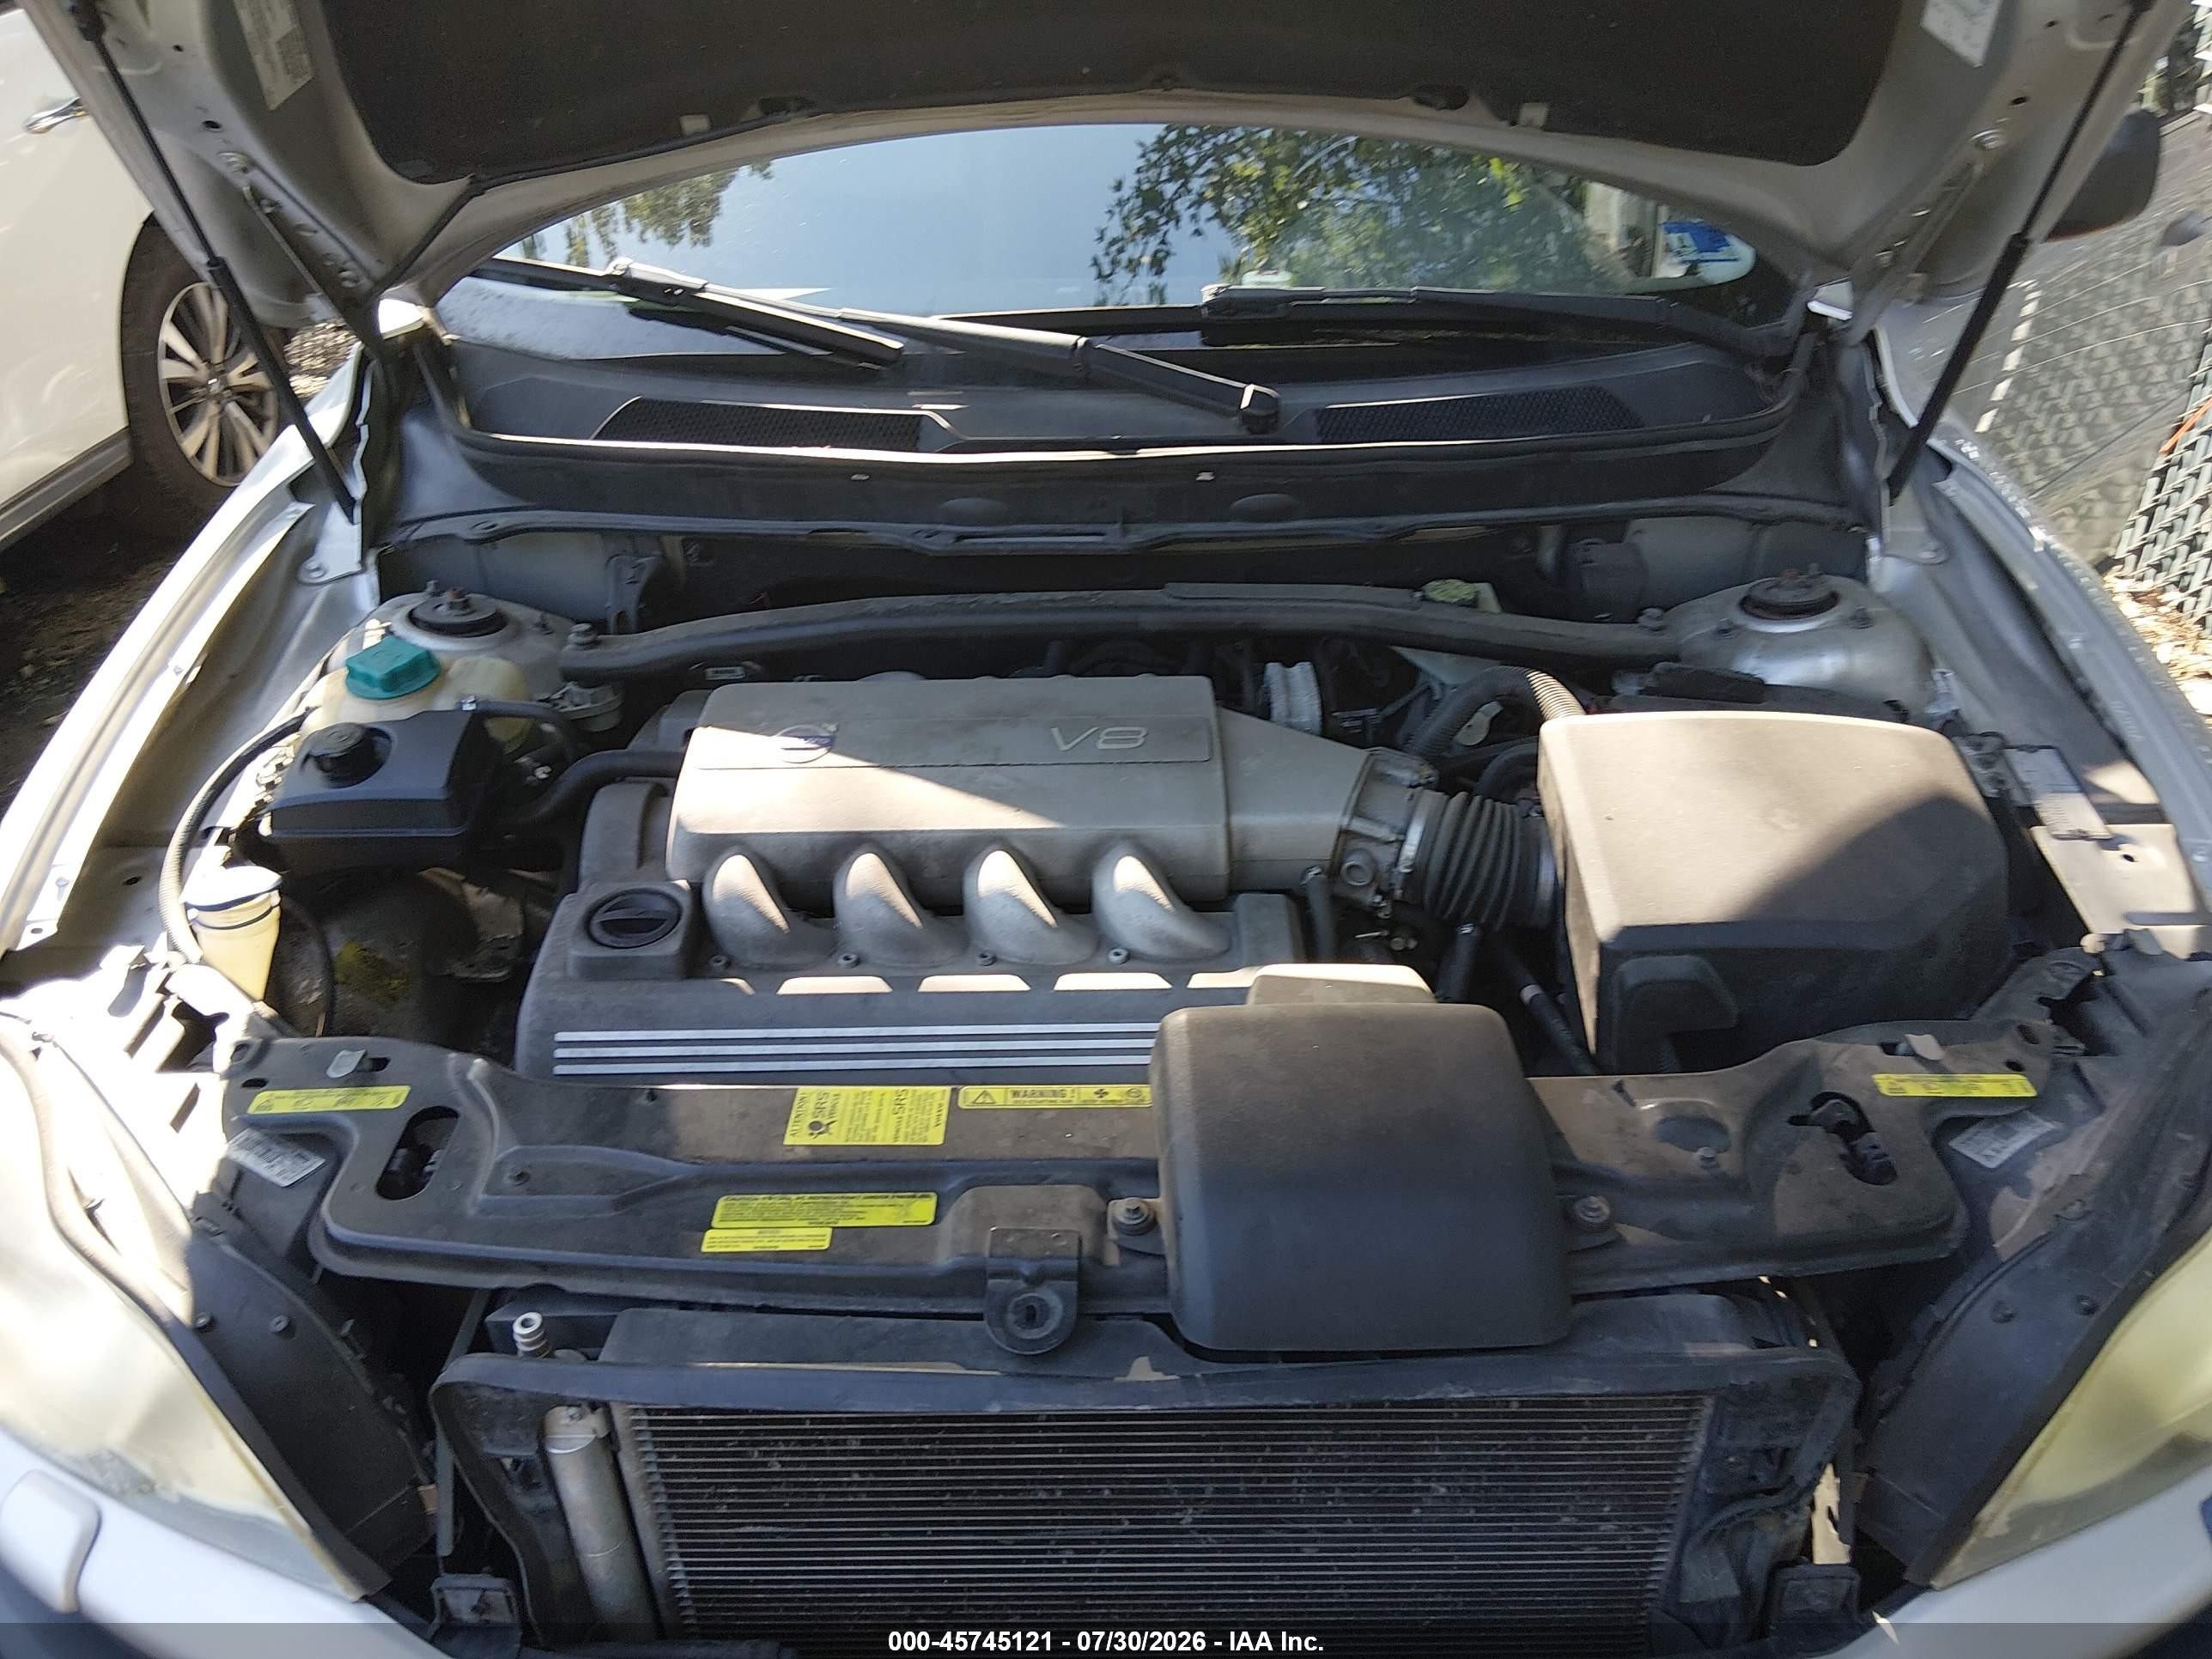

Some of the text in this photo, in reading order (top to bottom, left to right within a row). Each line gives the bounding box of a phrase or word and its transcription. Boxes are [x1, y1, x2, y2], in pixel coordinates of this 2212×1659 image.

[1050, 726, 1148, 751] V8
[813, 1091, 829, 1118] SRS
[893, 1088, 908, 1115] SRS
